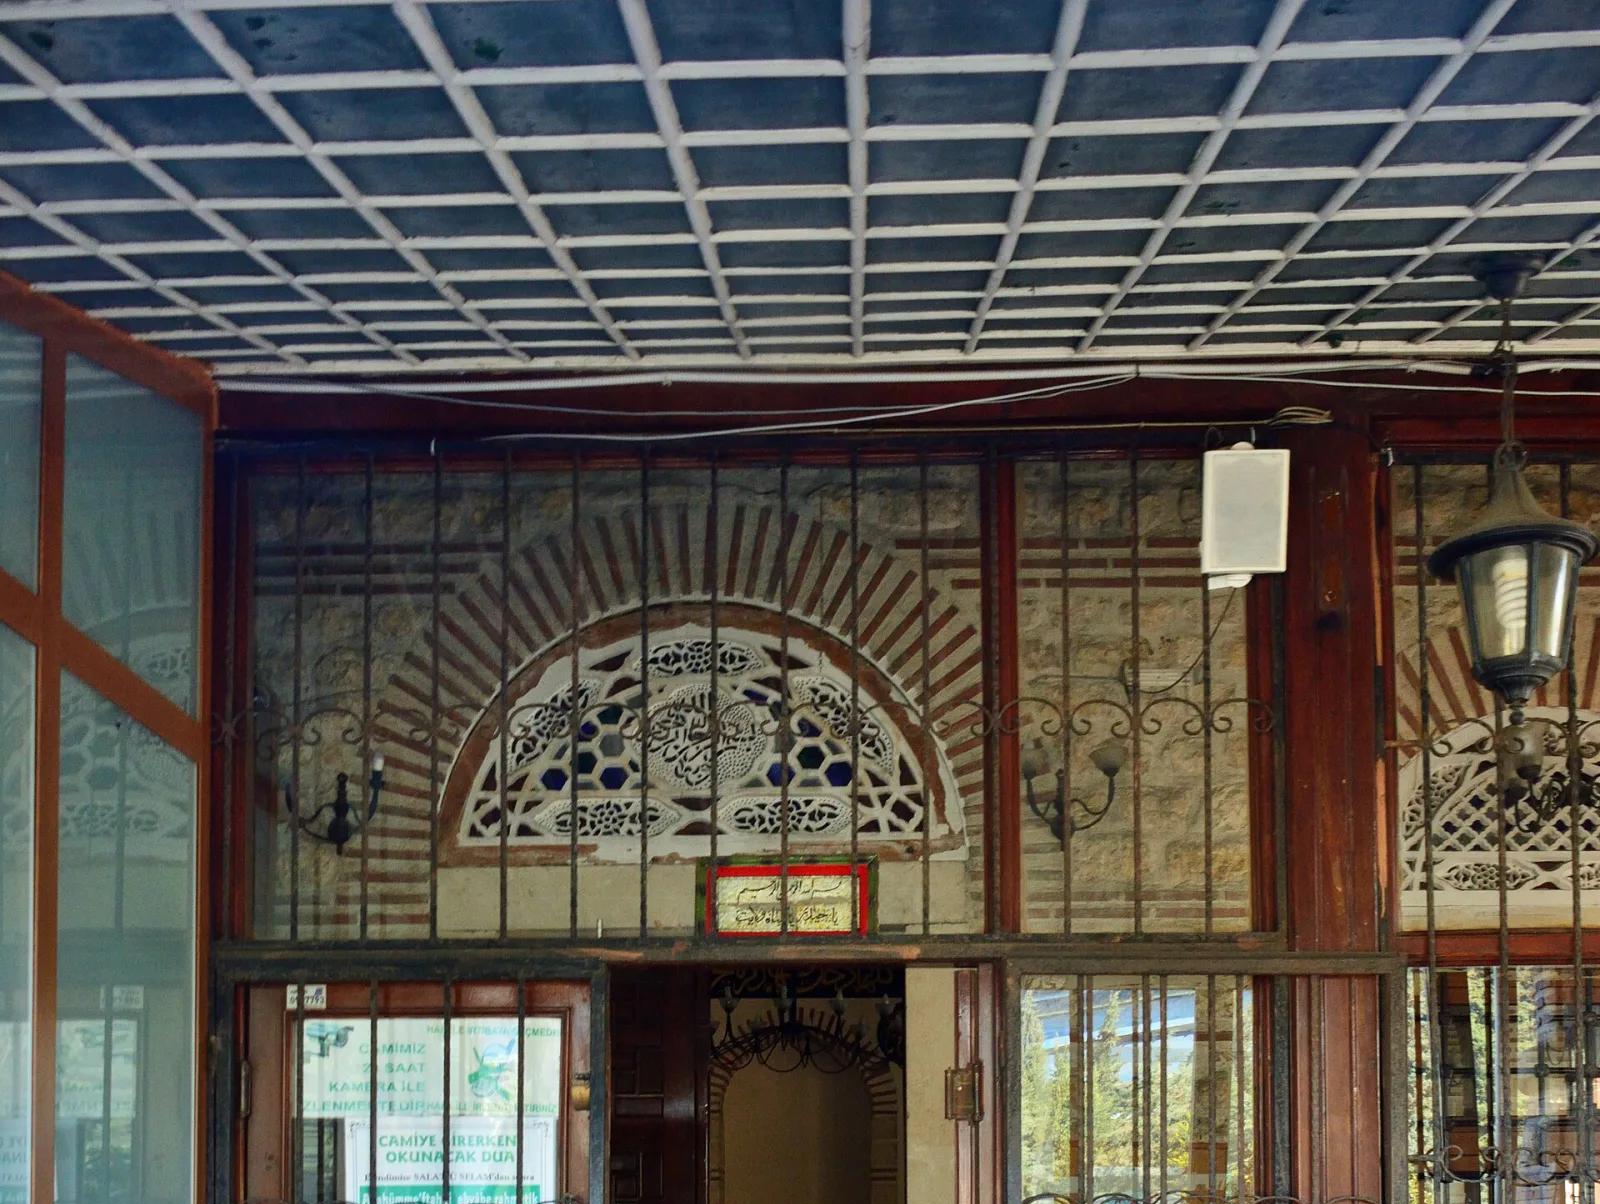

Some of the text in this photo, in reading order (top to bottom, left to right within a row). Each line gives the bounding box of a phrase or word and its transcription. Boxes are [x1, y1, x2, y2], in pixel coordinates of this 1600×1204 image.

[385, 1063, 426, 1073] SAAT
[401, 1080, 425, 1092] İLE
[300, 1100, 426, 1111] ZLENMETEDİR
[379, 1132, 517, 1147] CAMİYE İRERKEN
[482, 1151, 515, 1163] DUA
[494, 1191, 538, 1204] rahmtik
